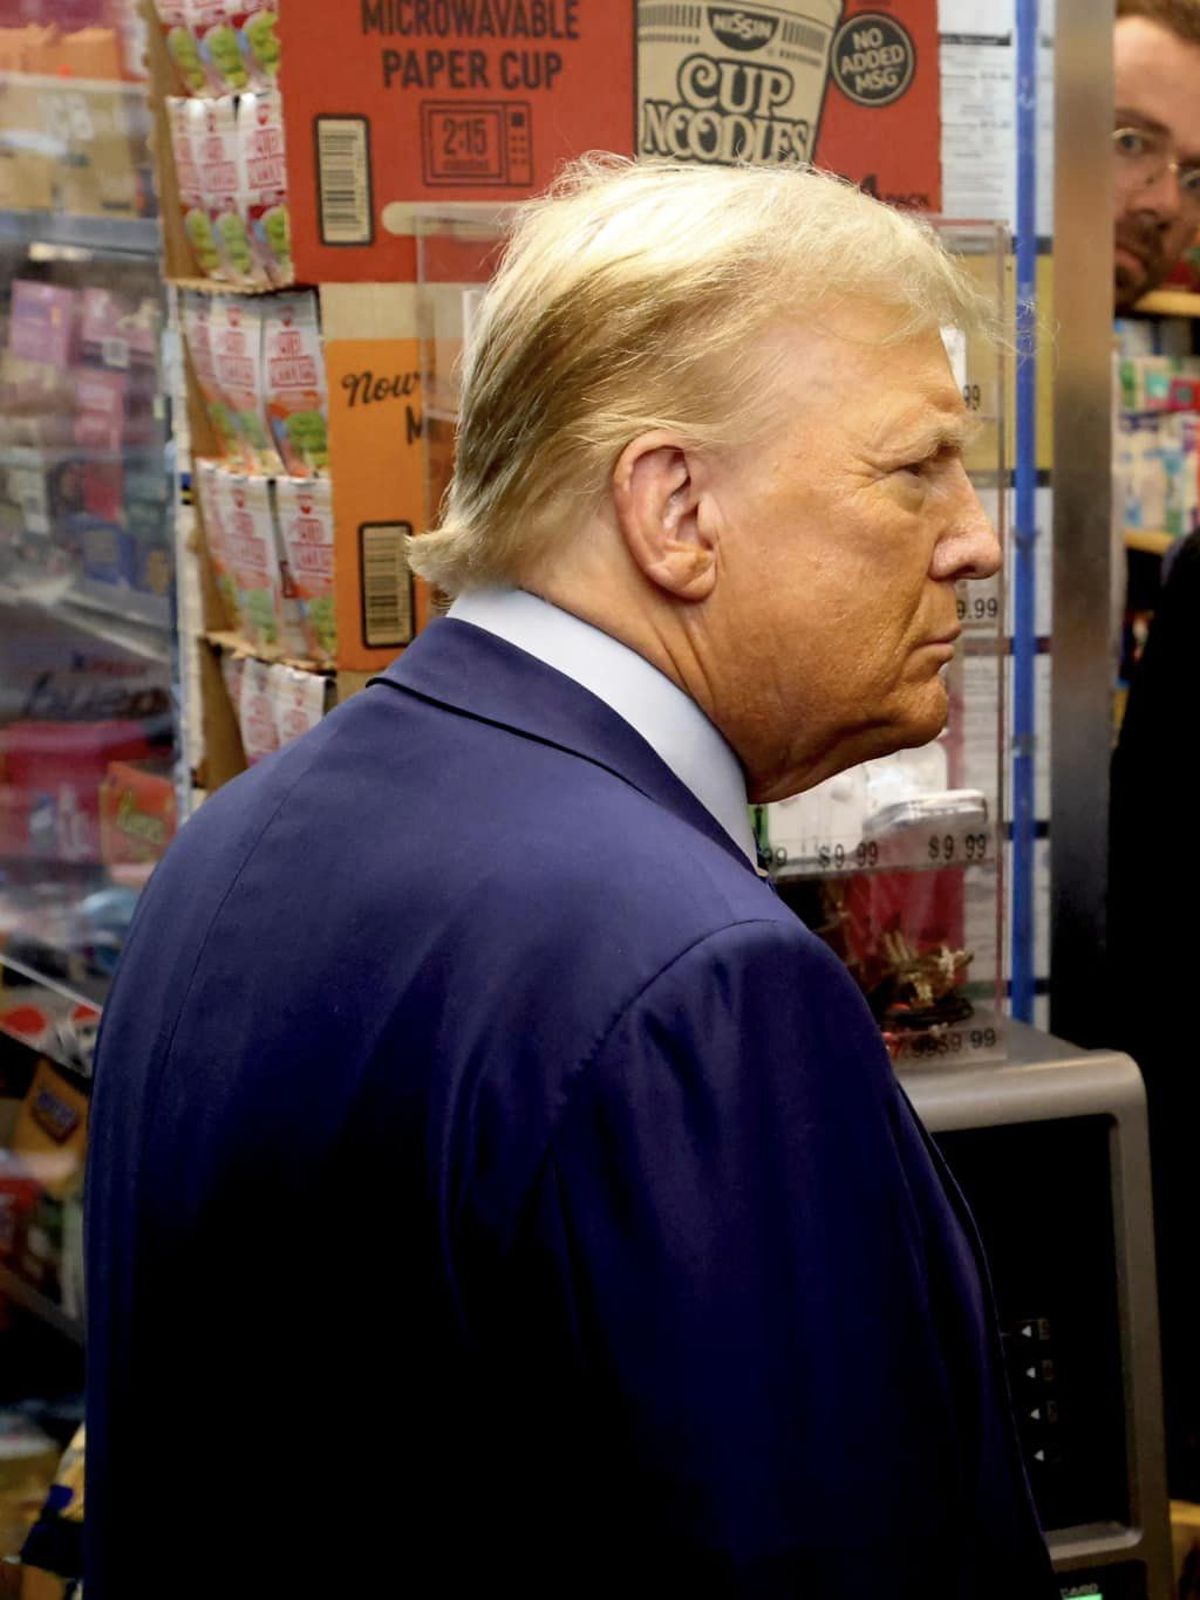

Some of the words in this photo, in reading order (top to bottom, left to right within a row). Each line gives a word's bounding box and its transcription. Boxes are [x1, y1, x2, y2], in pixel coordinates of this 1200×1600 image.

[361, 0, 580, 39] MICROWAVABLE
[852, 27, 883, 51] NO
[381, 48, 491, 89] PAPER
[501, 51, 562, 91] CUP
[841, 44, 905, 76] ADDED
[677, 53, 796, 118] CUP
[855, 67, 900, 94] MSG
[642, 100, 810, 165] NOODLES
